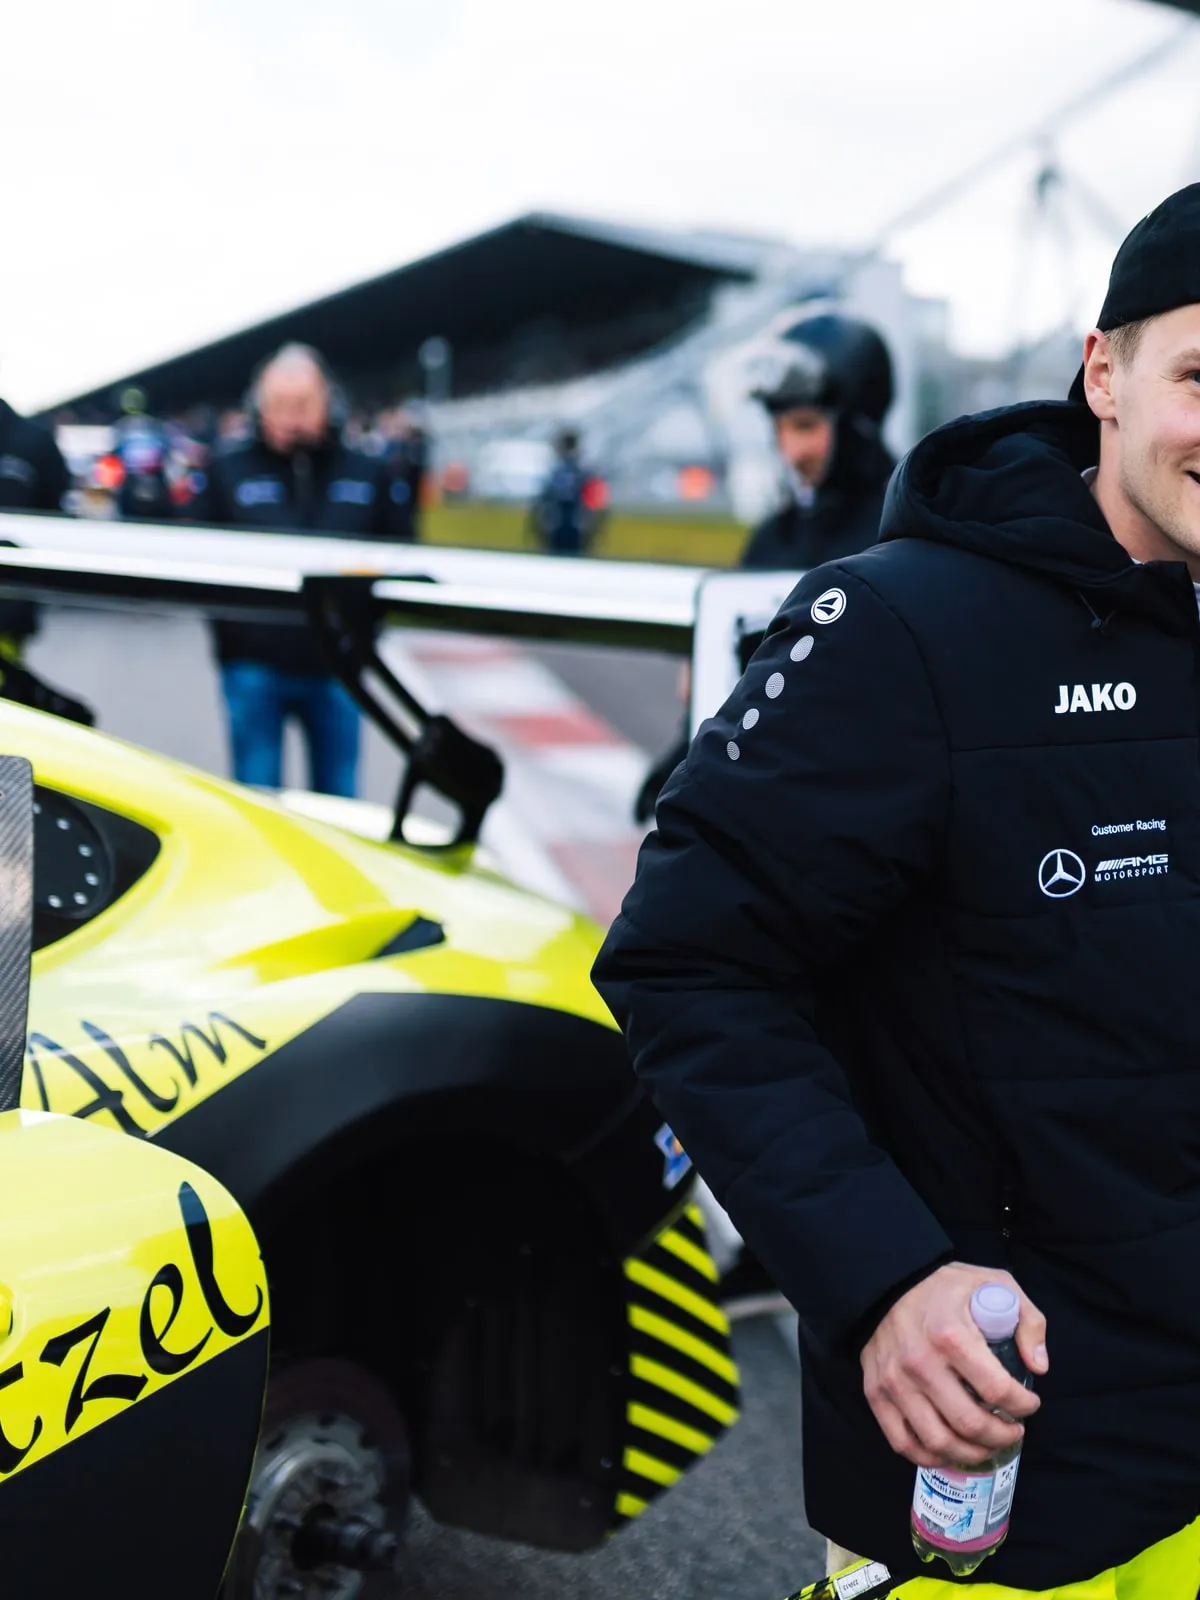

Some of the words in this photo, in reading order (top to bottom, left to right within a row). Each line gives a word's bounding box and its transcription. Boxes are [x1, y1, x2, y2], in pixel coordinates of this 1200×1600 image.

[1054, 682, 1137, 713] JAKO
[1091, 823, 1135, 836] Customer
[1136, 818, 1167, 831] Racing
[1119, 853, 1169, 868] AMG
[1094, 865, 1169, 882] MOTORSPORT
